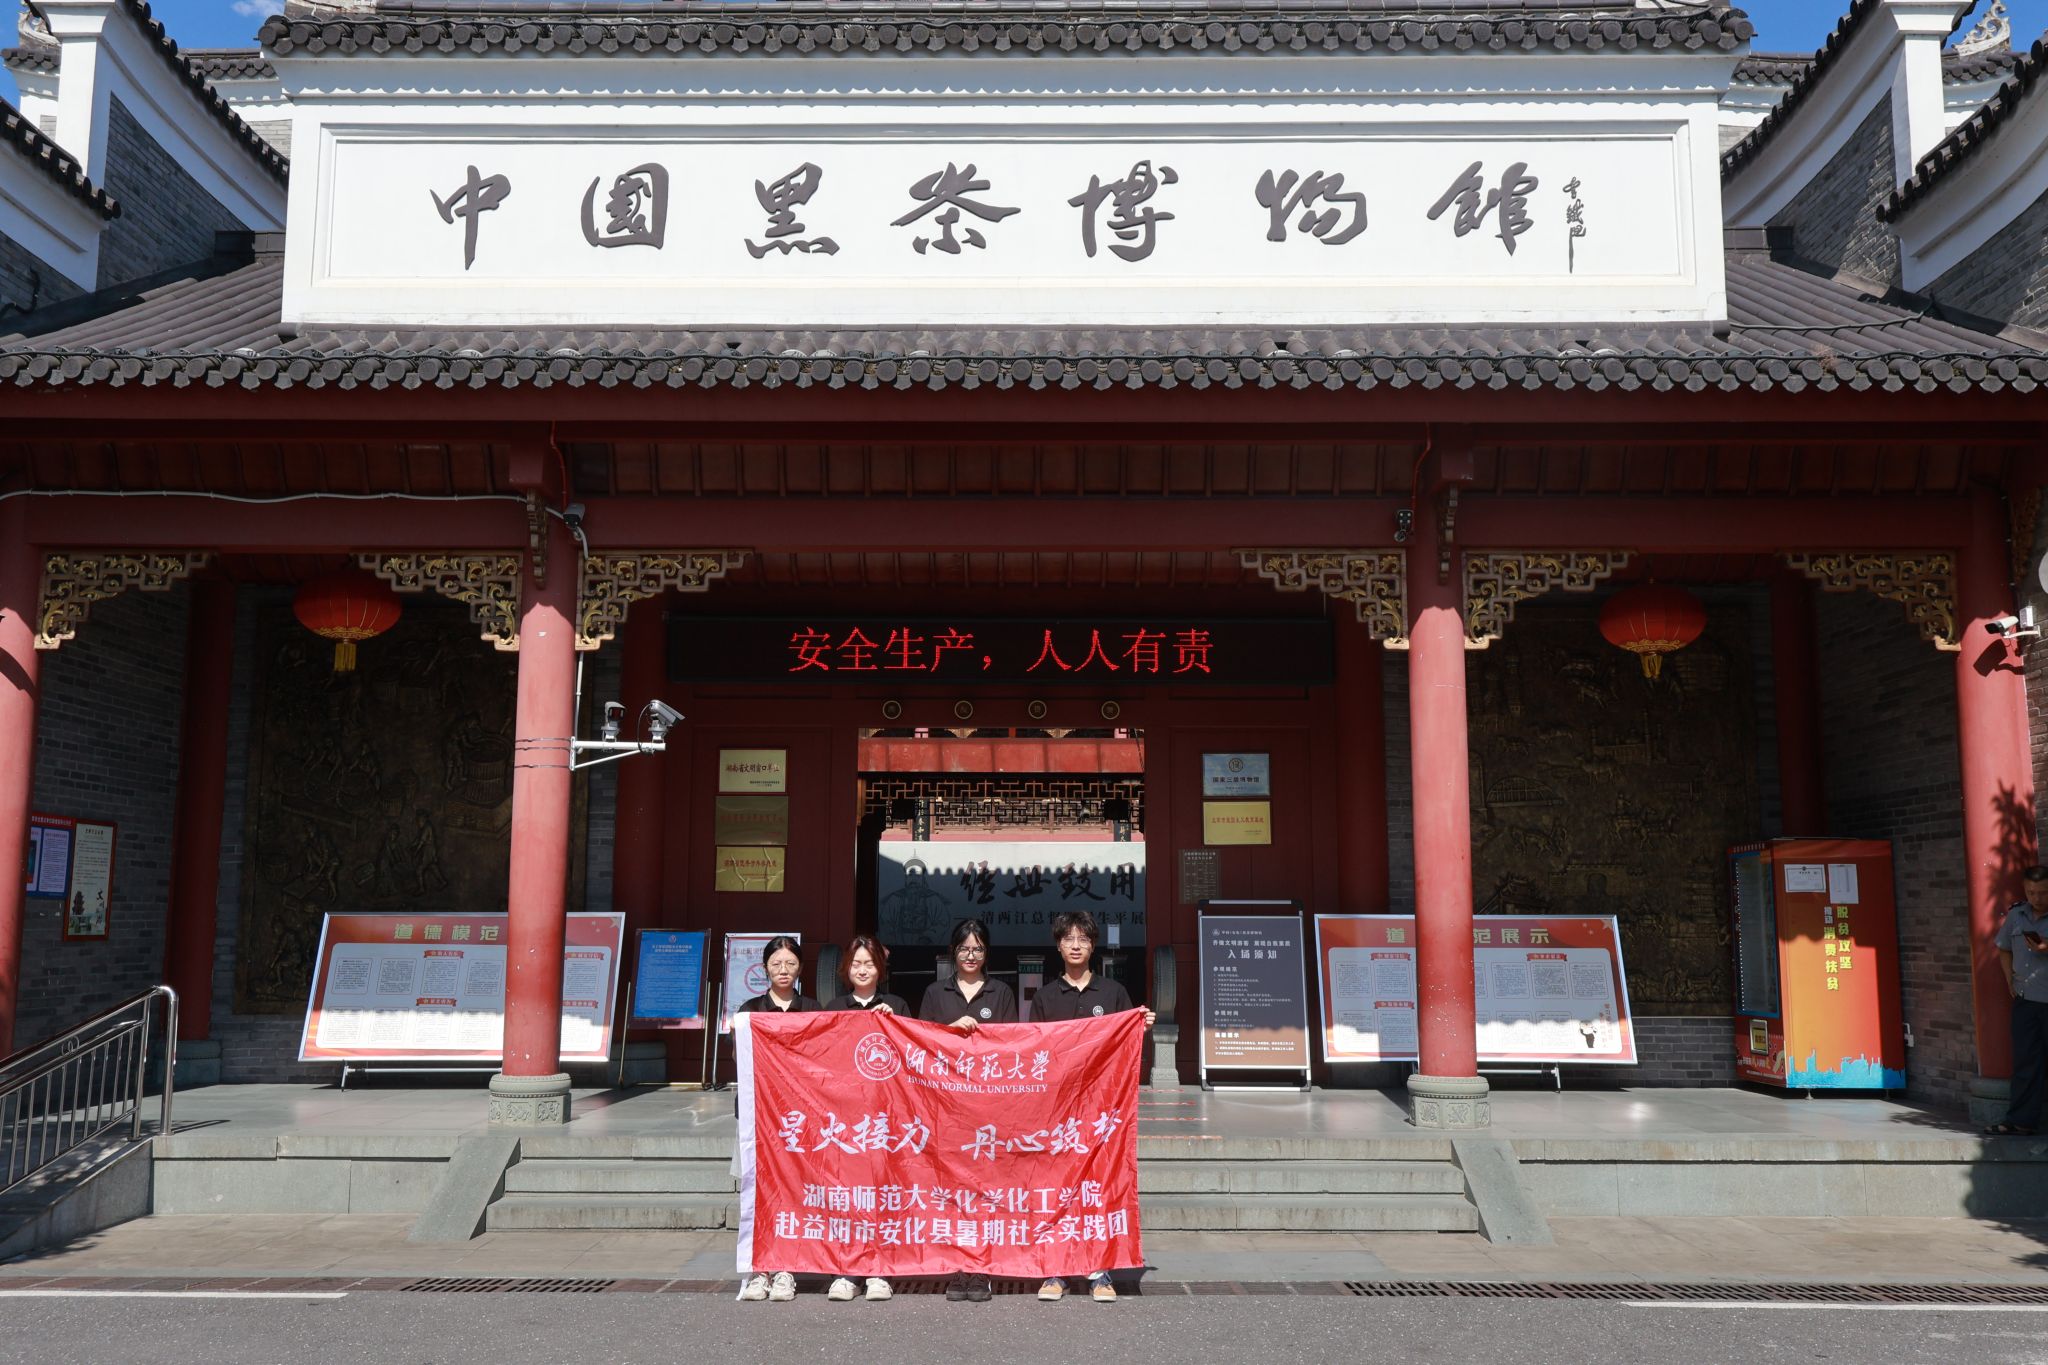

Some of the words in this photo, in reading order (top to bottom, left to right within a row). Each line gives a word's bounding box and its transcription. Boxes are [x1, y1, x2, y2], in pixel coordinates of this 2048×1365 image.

[908, 1075, 939, 1089] HUNAN
[941, 1083, 986, 1094] NORMAL
[987, 1084, 1048, 1094] UNIVERSITY
[778, 1110, 931, 1155] 星火接力
[802, 1180, 1103, 1215] 湖南师范大学化学化工学院
[774, 1209, 1129, 1247] 赴益阳市安化县暑期社会实践团
